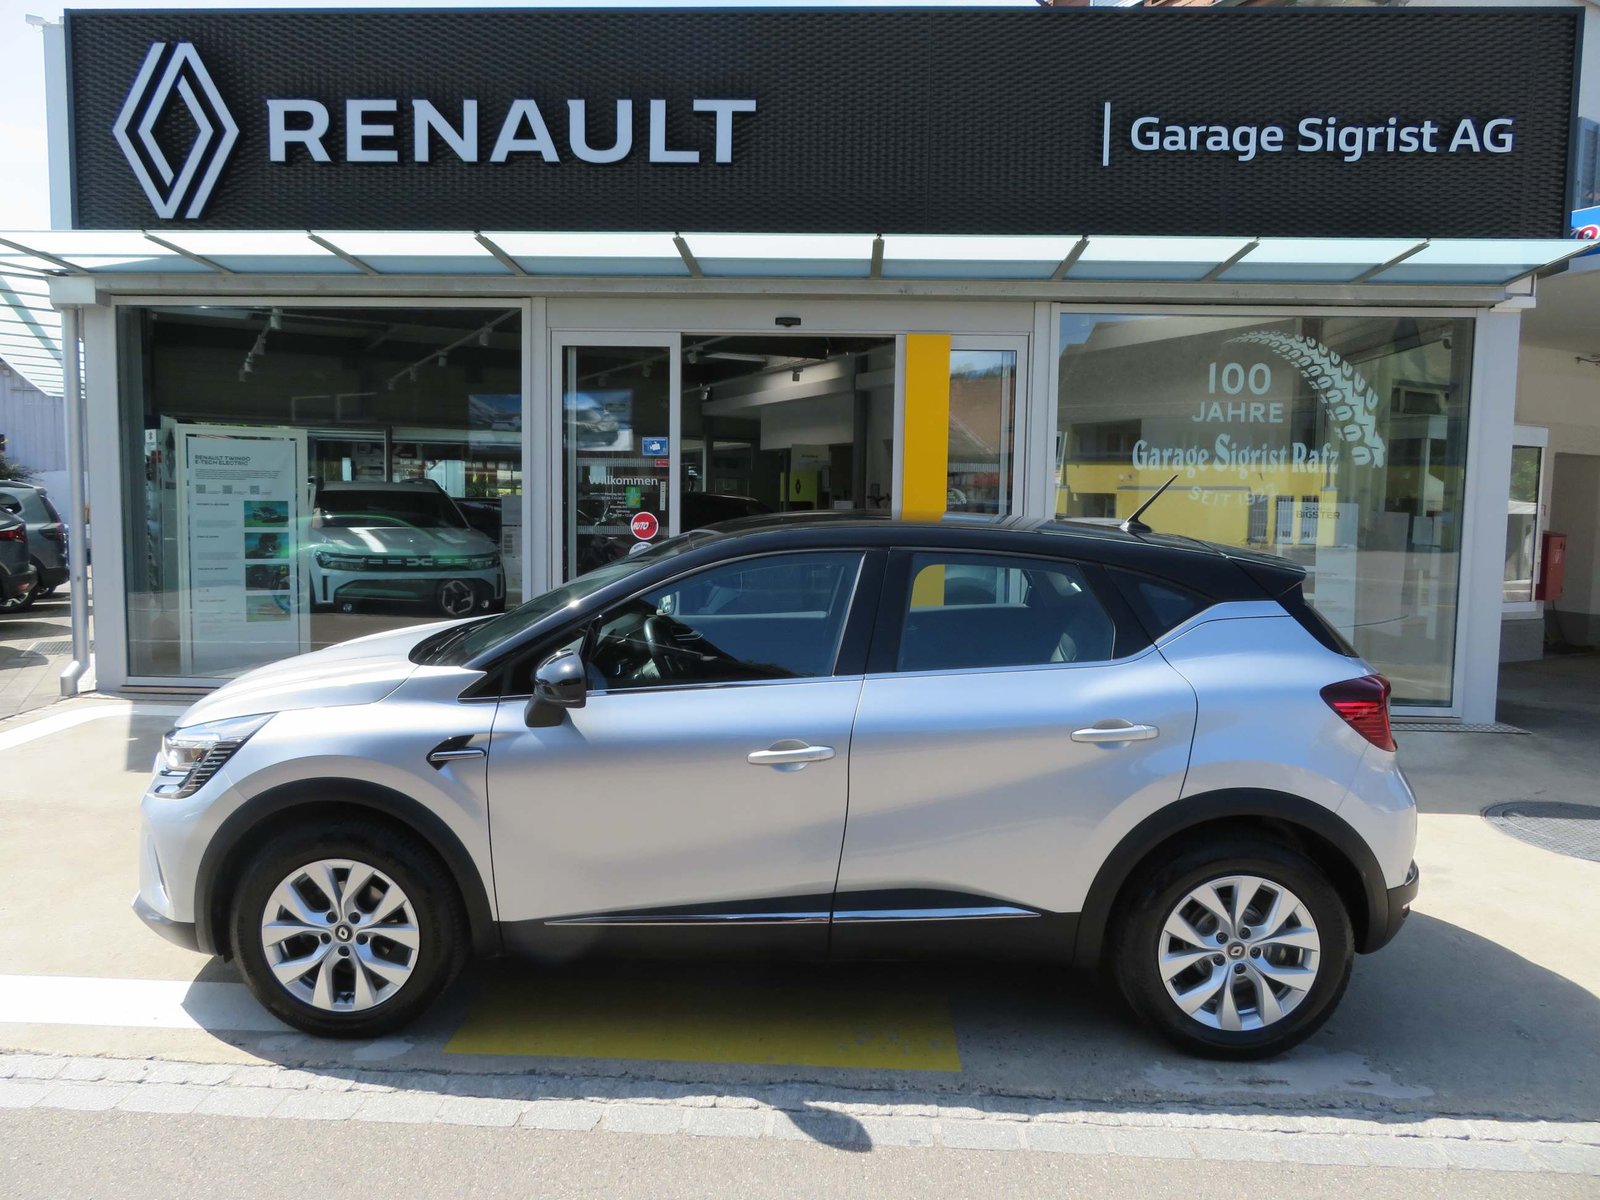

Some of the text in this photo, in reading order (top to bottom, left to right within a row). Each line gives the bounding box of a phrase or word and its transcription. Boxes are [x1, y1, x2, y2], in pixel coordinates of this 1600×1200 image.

[267, 98, 757, 164] RENAULT
[1130, 116, 1514, 162] Garage Sigrist AG
[1208, 362, 1271, 395] 100
[1192, 402, 1284, 424] JAHRE
[1132, 433, 1340, 480] Garage Sigrist Rafz
[588, 475, 659, 486] Willkommen
[1189, 486, 1231, 507] SEIT
